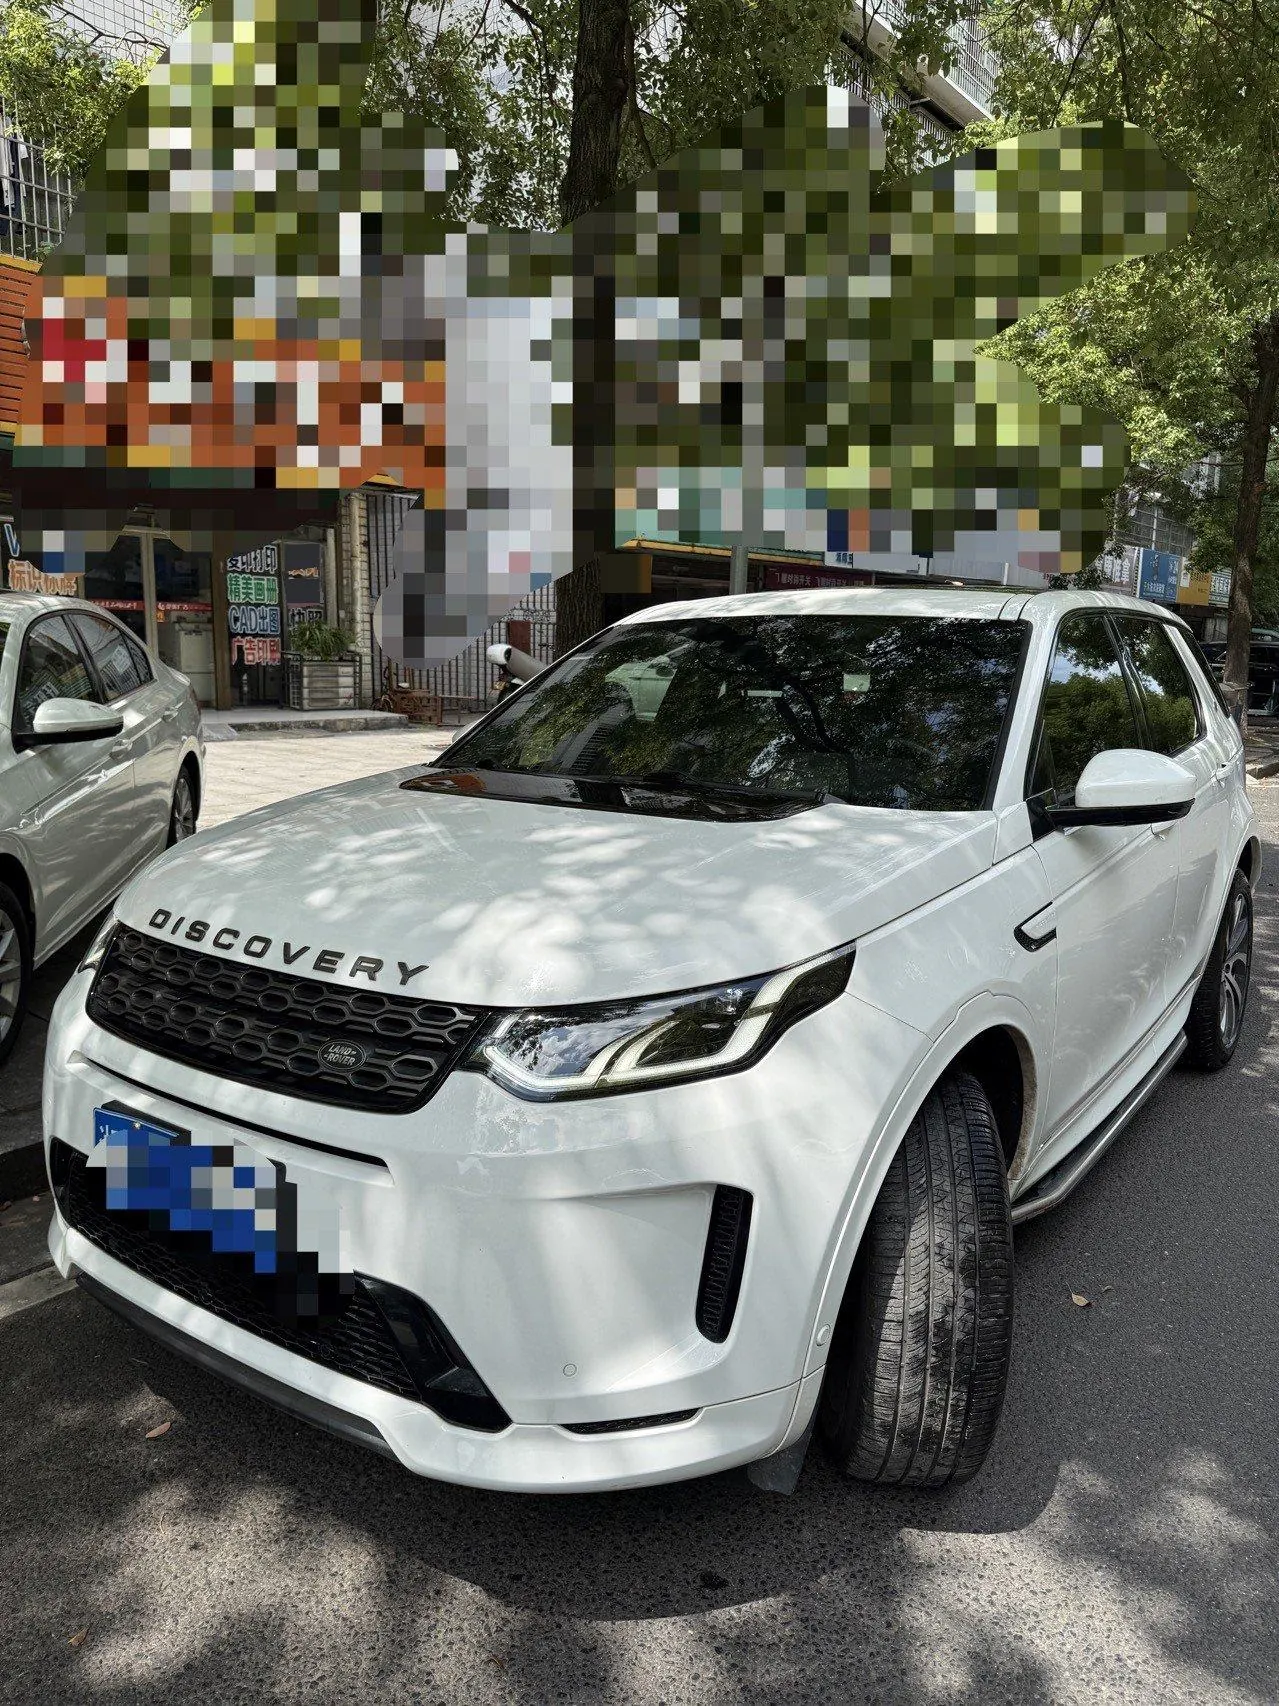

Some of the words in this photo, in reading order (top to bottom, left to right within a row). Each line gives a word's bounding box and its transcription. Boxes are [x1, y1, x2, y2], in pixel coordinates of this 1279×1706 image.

[228, 573, 279, 605] 精美画册
[229, 605, 281, 634] CAD出图
[231, 636, 281, 665] 广告印刷
[148, 908, 430, 986] DISCOVERY
